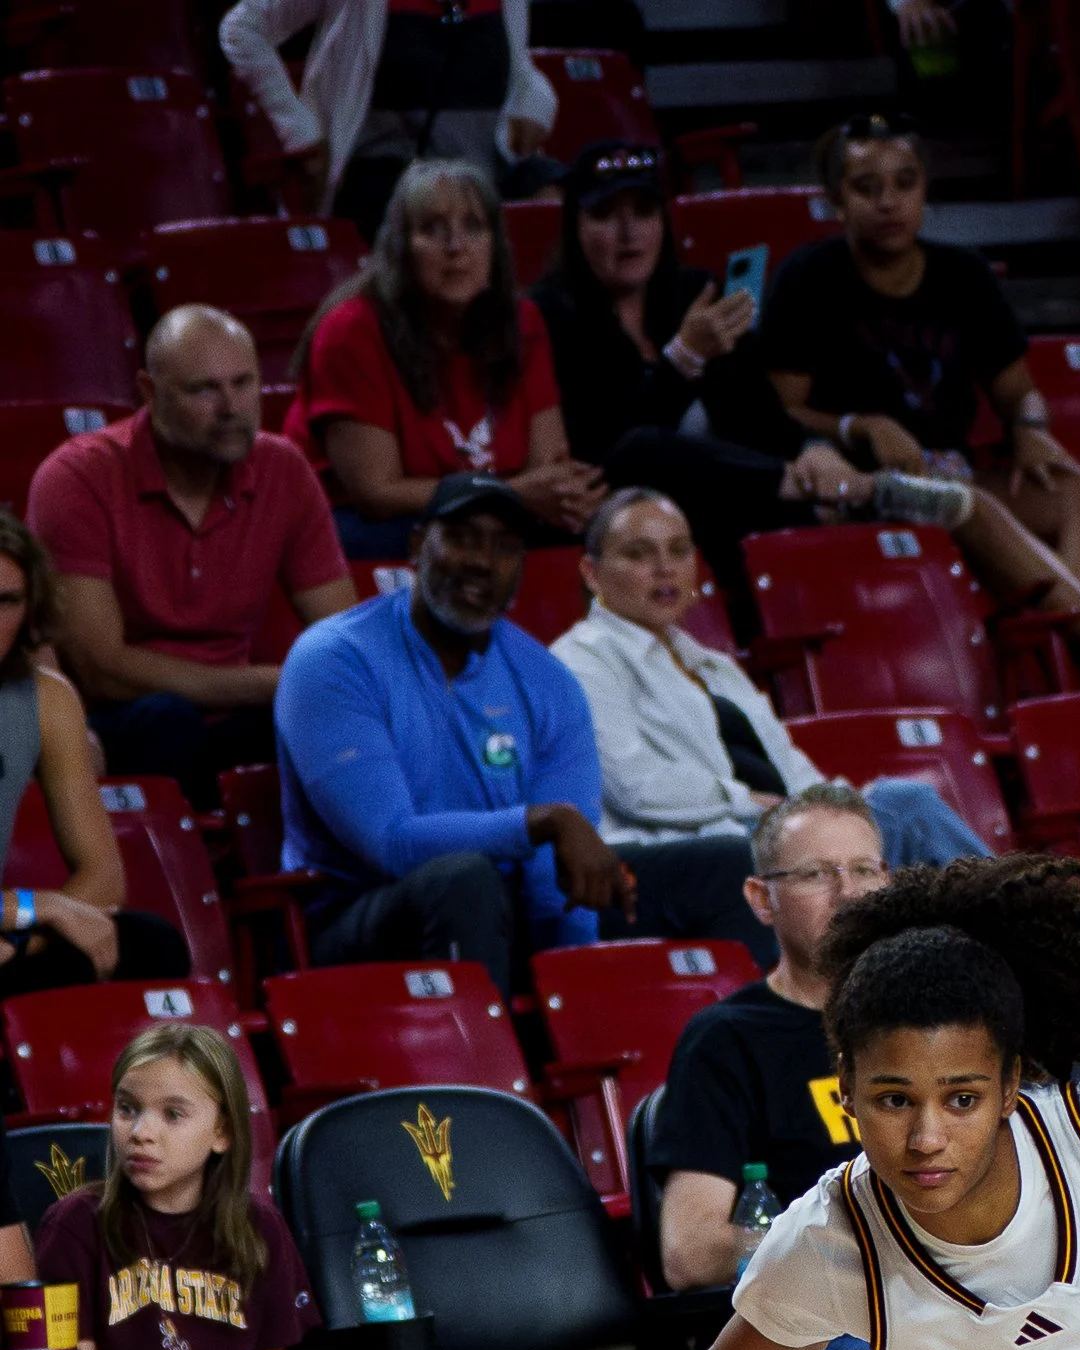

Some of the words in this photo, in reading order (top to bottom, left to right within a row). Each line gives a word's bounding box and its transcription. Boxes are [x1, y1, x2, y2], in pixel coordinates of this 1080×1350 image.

[162, 992, 176, 1016] 4
[109, 1257, 174, 1326] ARIZA
[176, 1268, 248, 1329] STATE
